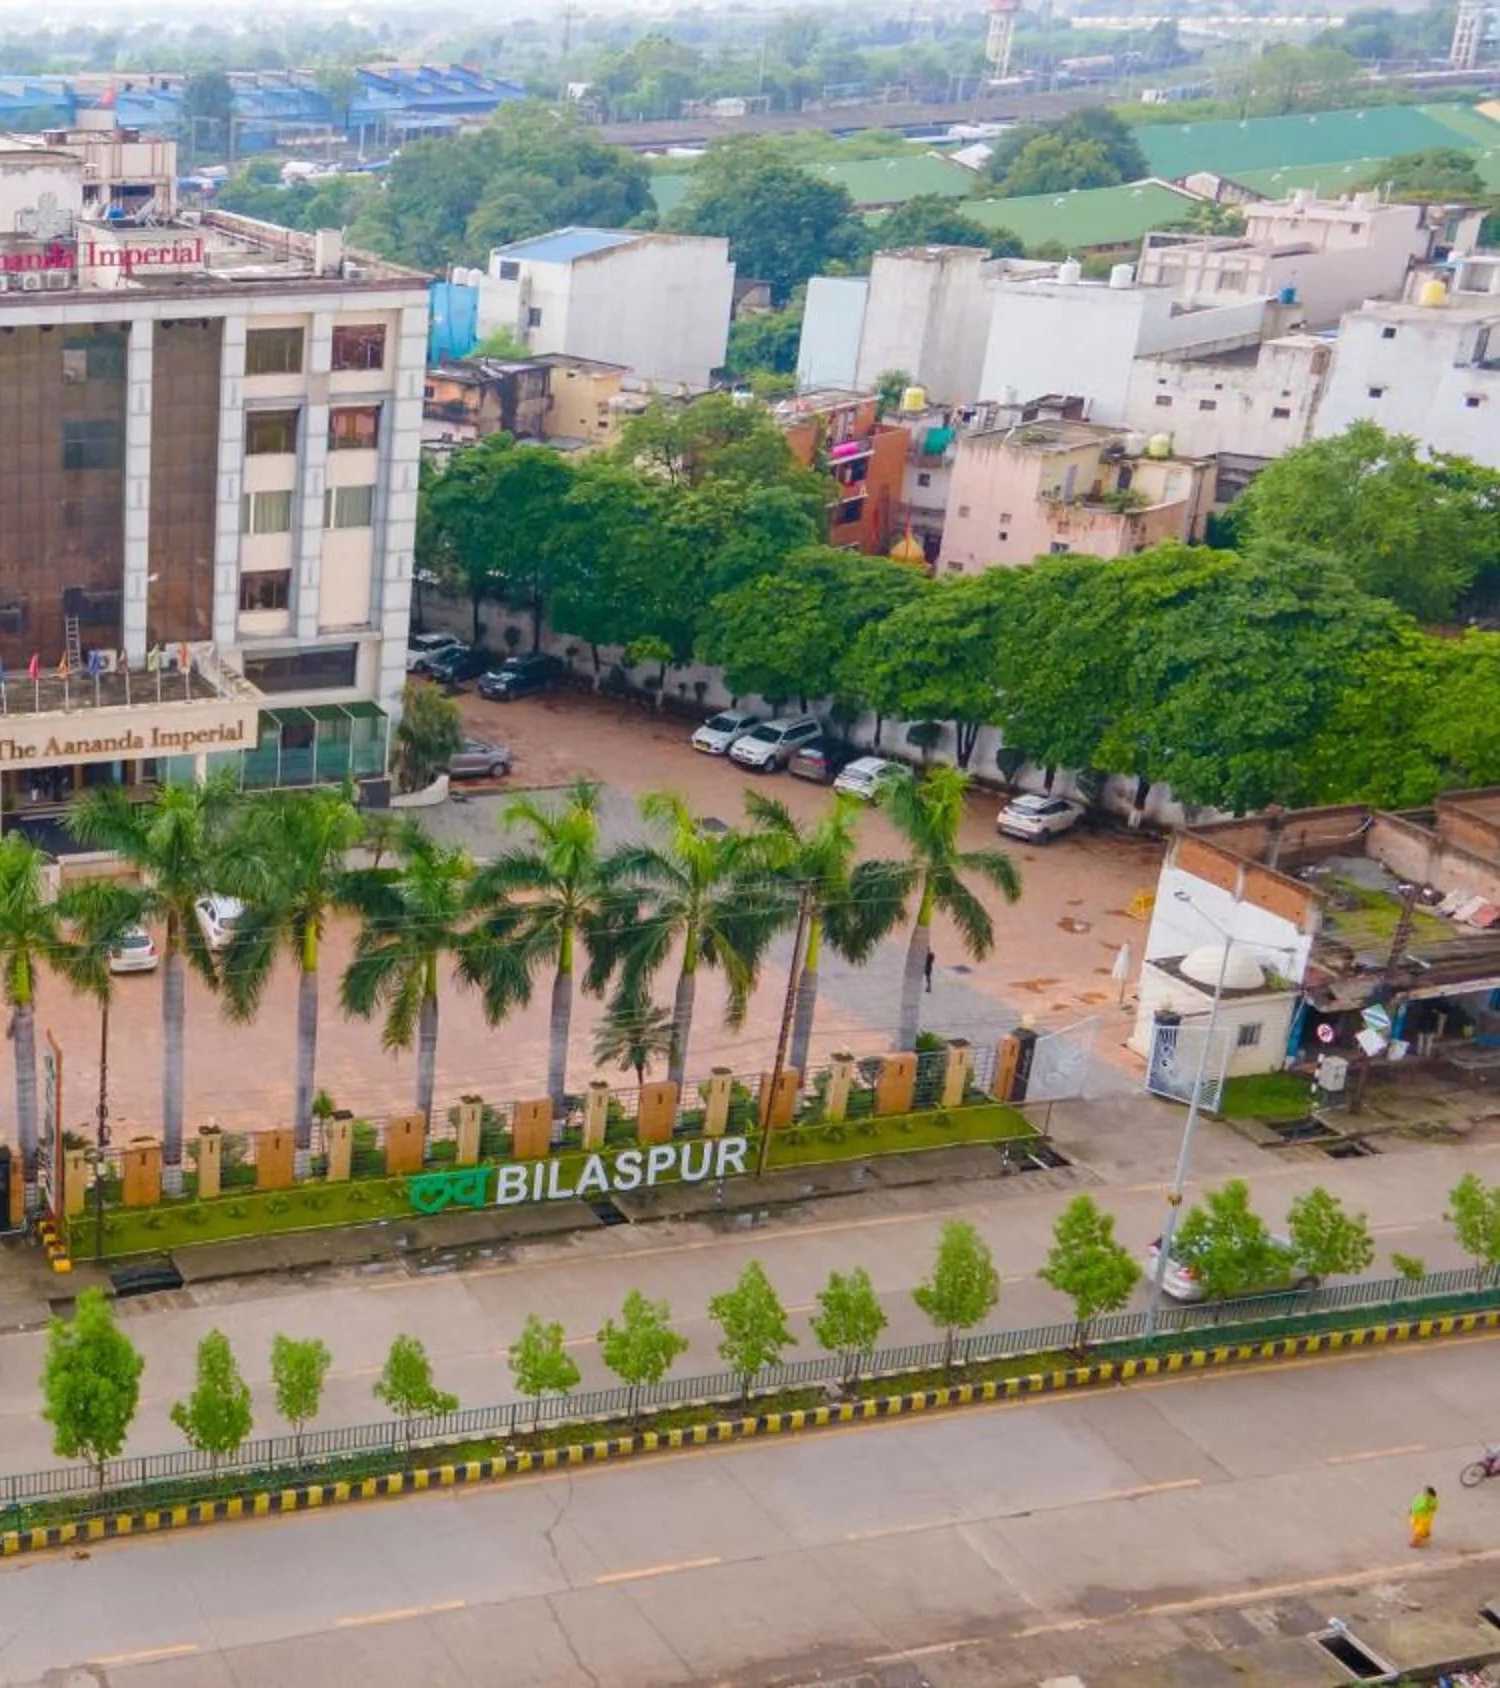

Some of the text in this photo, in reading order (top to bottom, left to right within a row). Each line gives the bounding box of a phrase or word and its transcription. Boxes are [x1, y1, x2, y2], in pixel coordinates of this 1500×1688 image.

[88, 238, 202, 276] Imperial
[44, 730, 144, 757] Aananda
[151, 720, 244, 751] Imperial
[496, 1136, 747, 1205] BILASPUR
